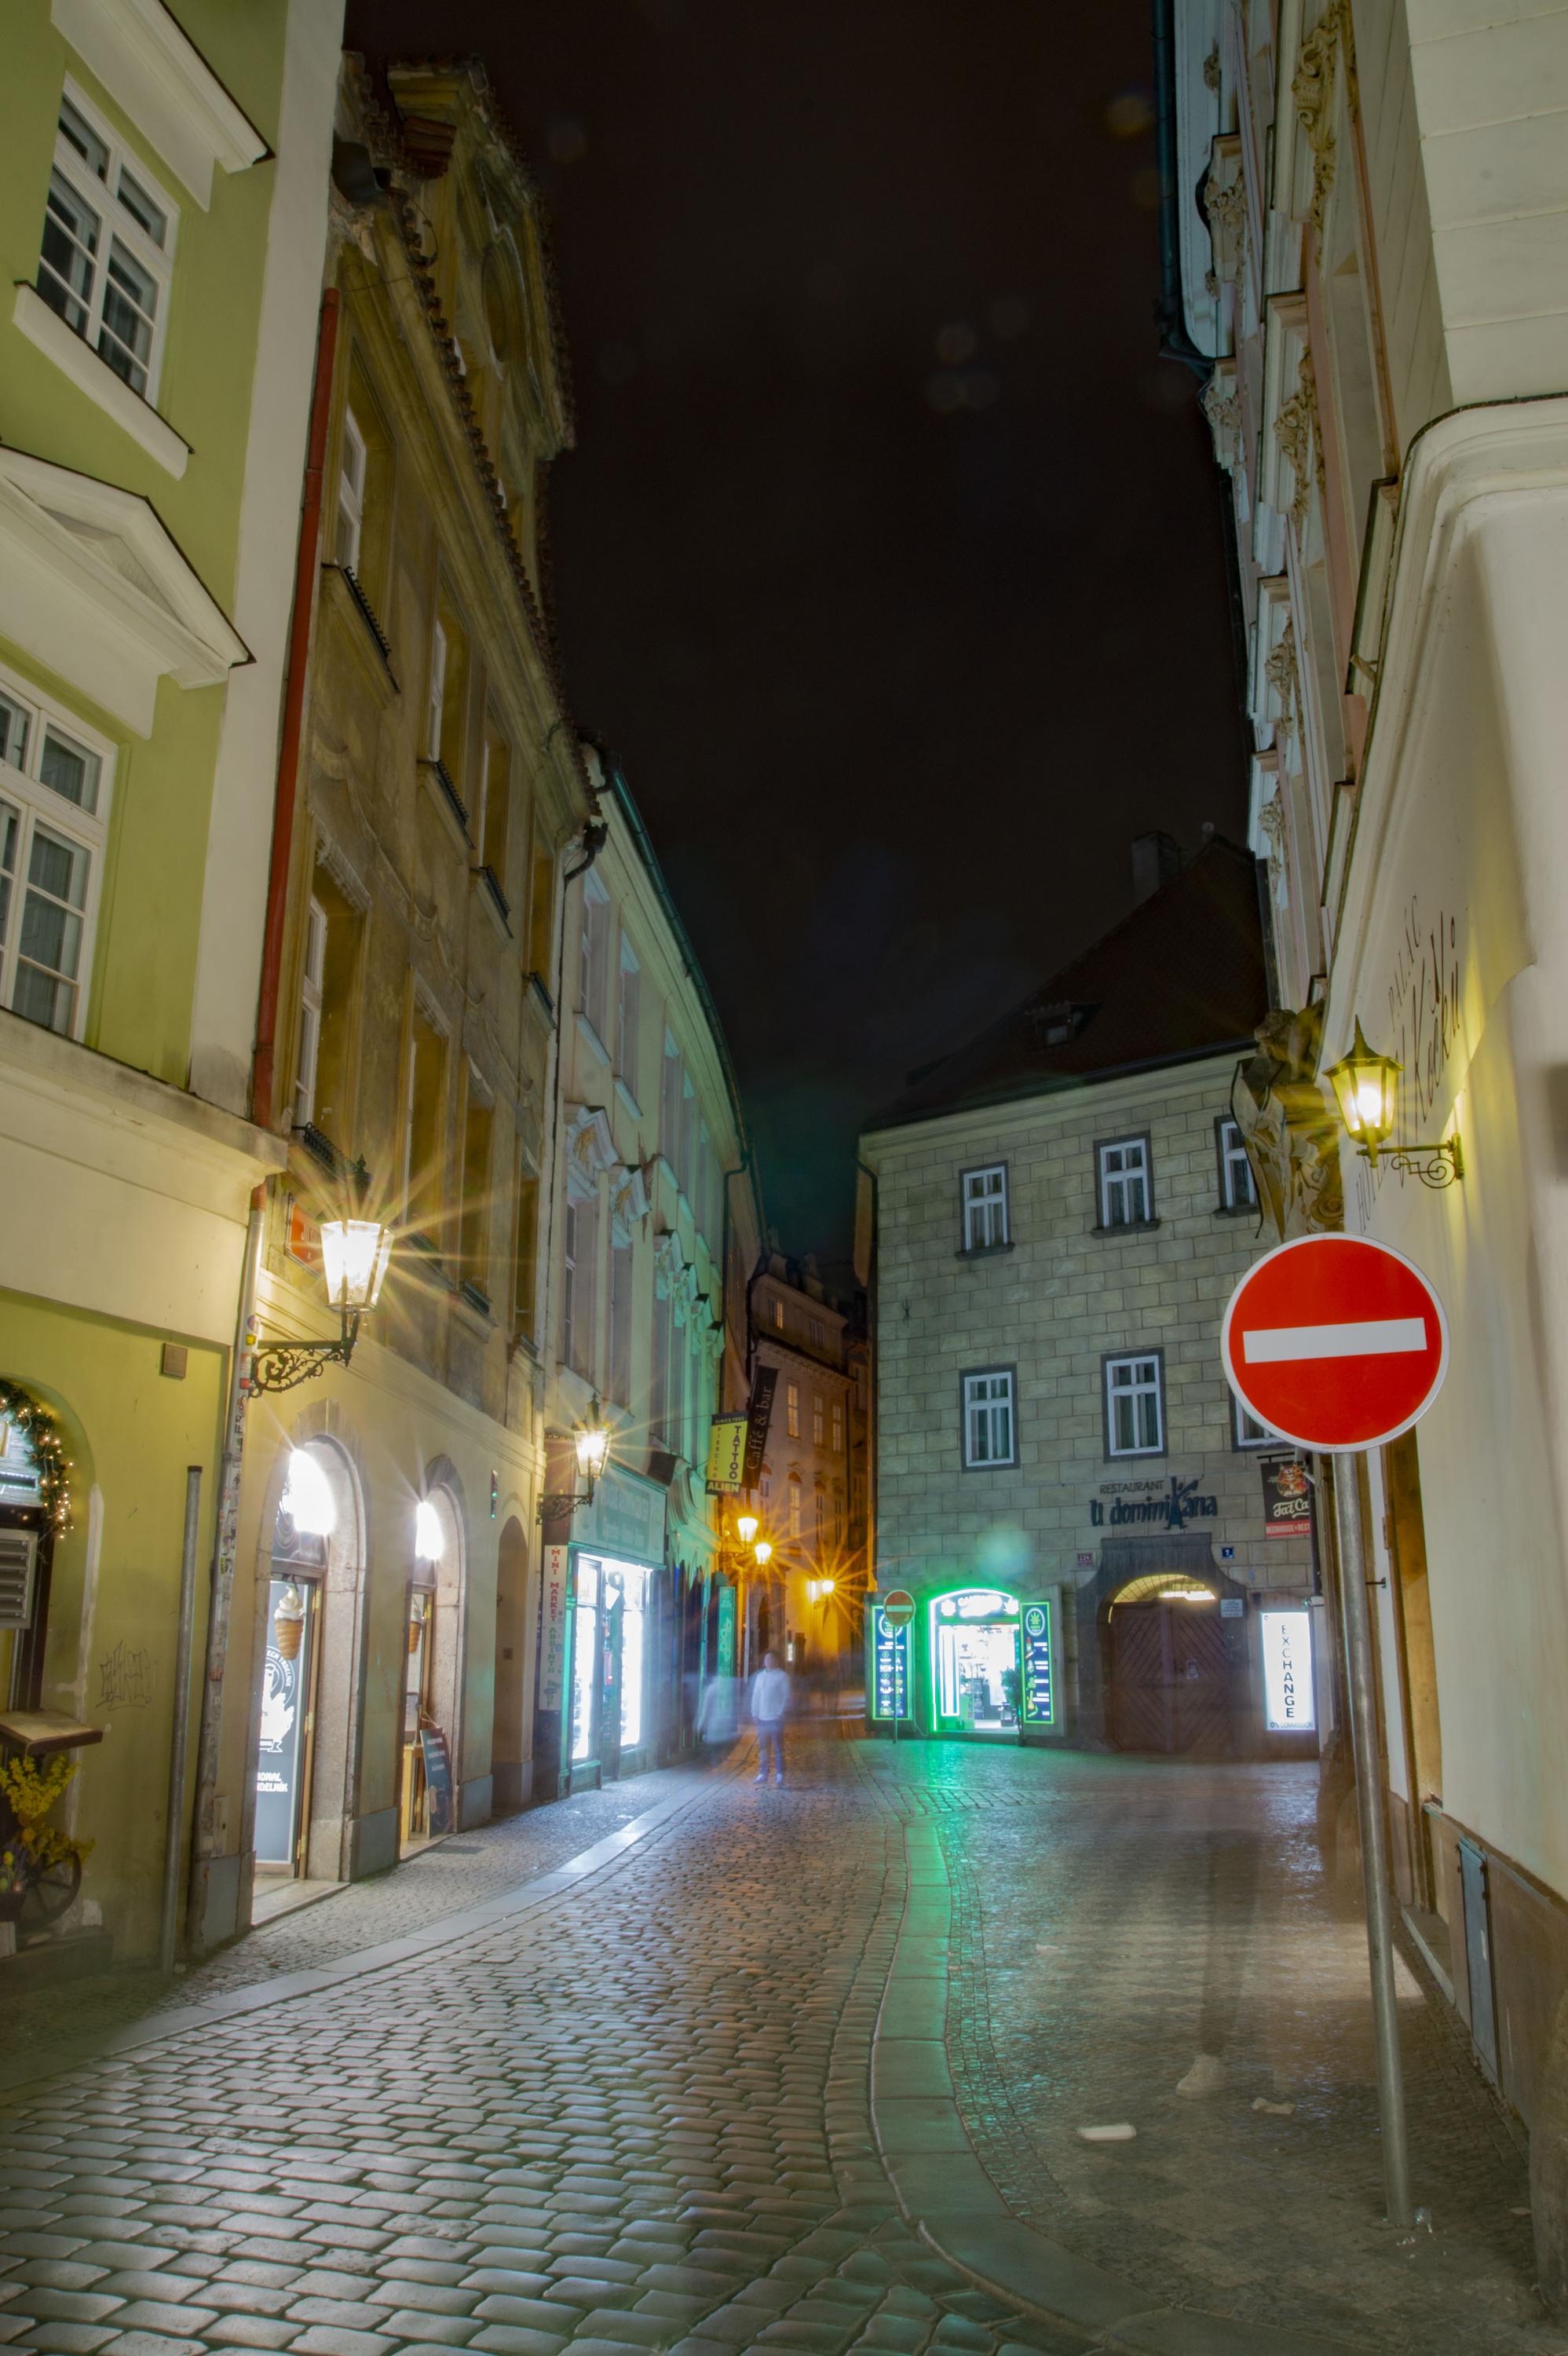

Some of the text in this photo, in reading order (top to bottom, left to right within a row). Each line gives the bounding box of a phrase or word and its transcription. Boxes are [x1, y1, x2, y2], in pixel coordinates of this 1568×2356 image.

[755, 1387, 771, 1408] bar
[729, 1426, 741, 1480] TATTOO
[707, 1481, 740, 1492] ALIEN
[1100, 1480, 1164, 1494] RESTAURANT
[1273, 1501, 1296, 1517] Fat
[551, 1549, 561, 1575] MINI
[550, 1582, 559, 1622] MARKET
[547, 1627, 557, 1673] ABSINTH
[1281, 1625, 1295, 1718] EXCHANGE
